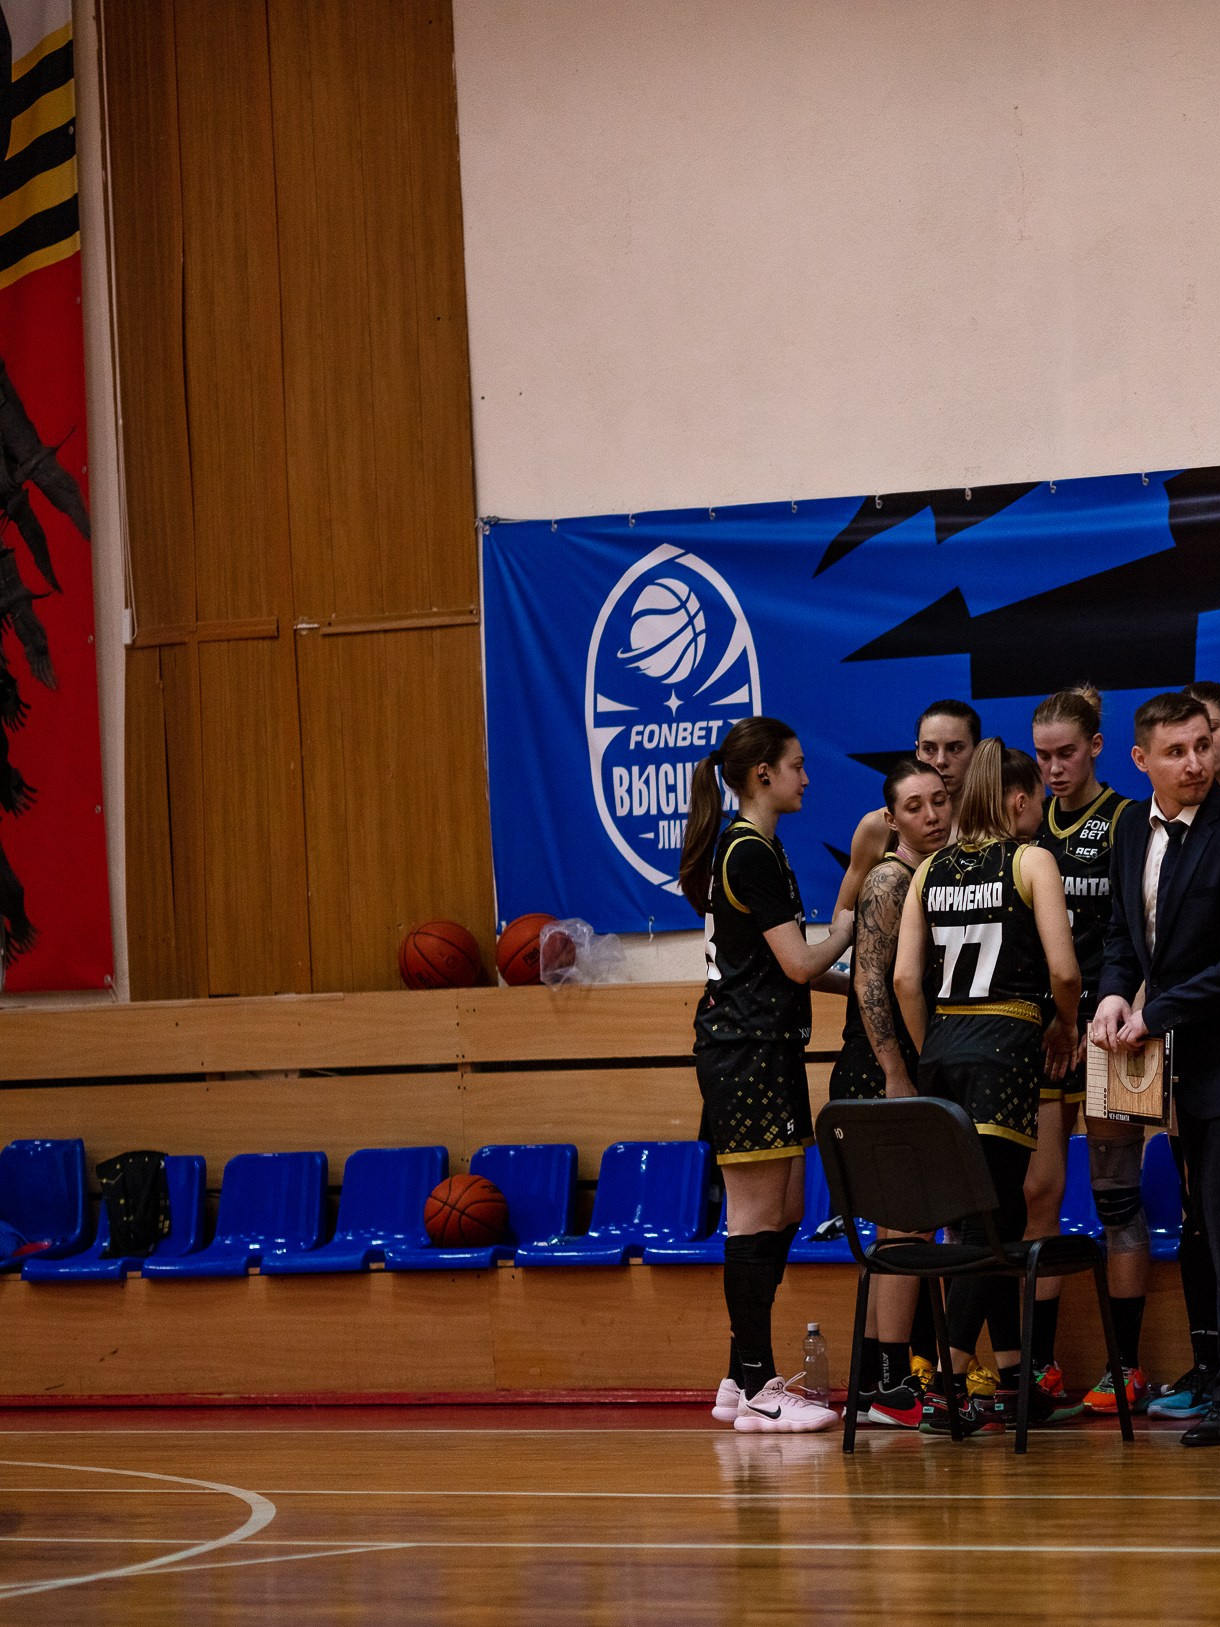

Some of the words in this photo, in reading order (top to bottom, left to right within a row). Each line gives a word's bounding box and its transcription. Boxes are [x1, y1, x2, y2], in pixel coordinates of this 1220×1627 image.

[629, 720, 723, 750] FONBET
[1079, 829, 1105, 840] BET
[1084, 819, 1110, 831] FON
[927, 881, 1003, 913] КИРИЛЕНКО
[1061, 875, 1110, 896] АНТА
[931, 922, 1003, 999] 77
